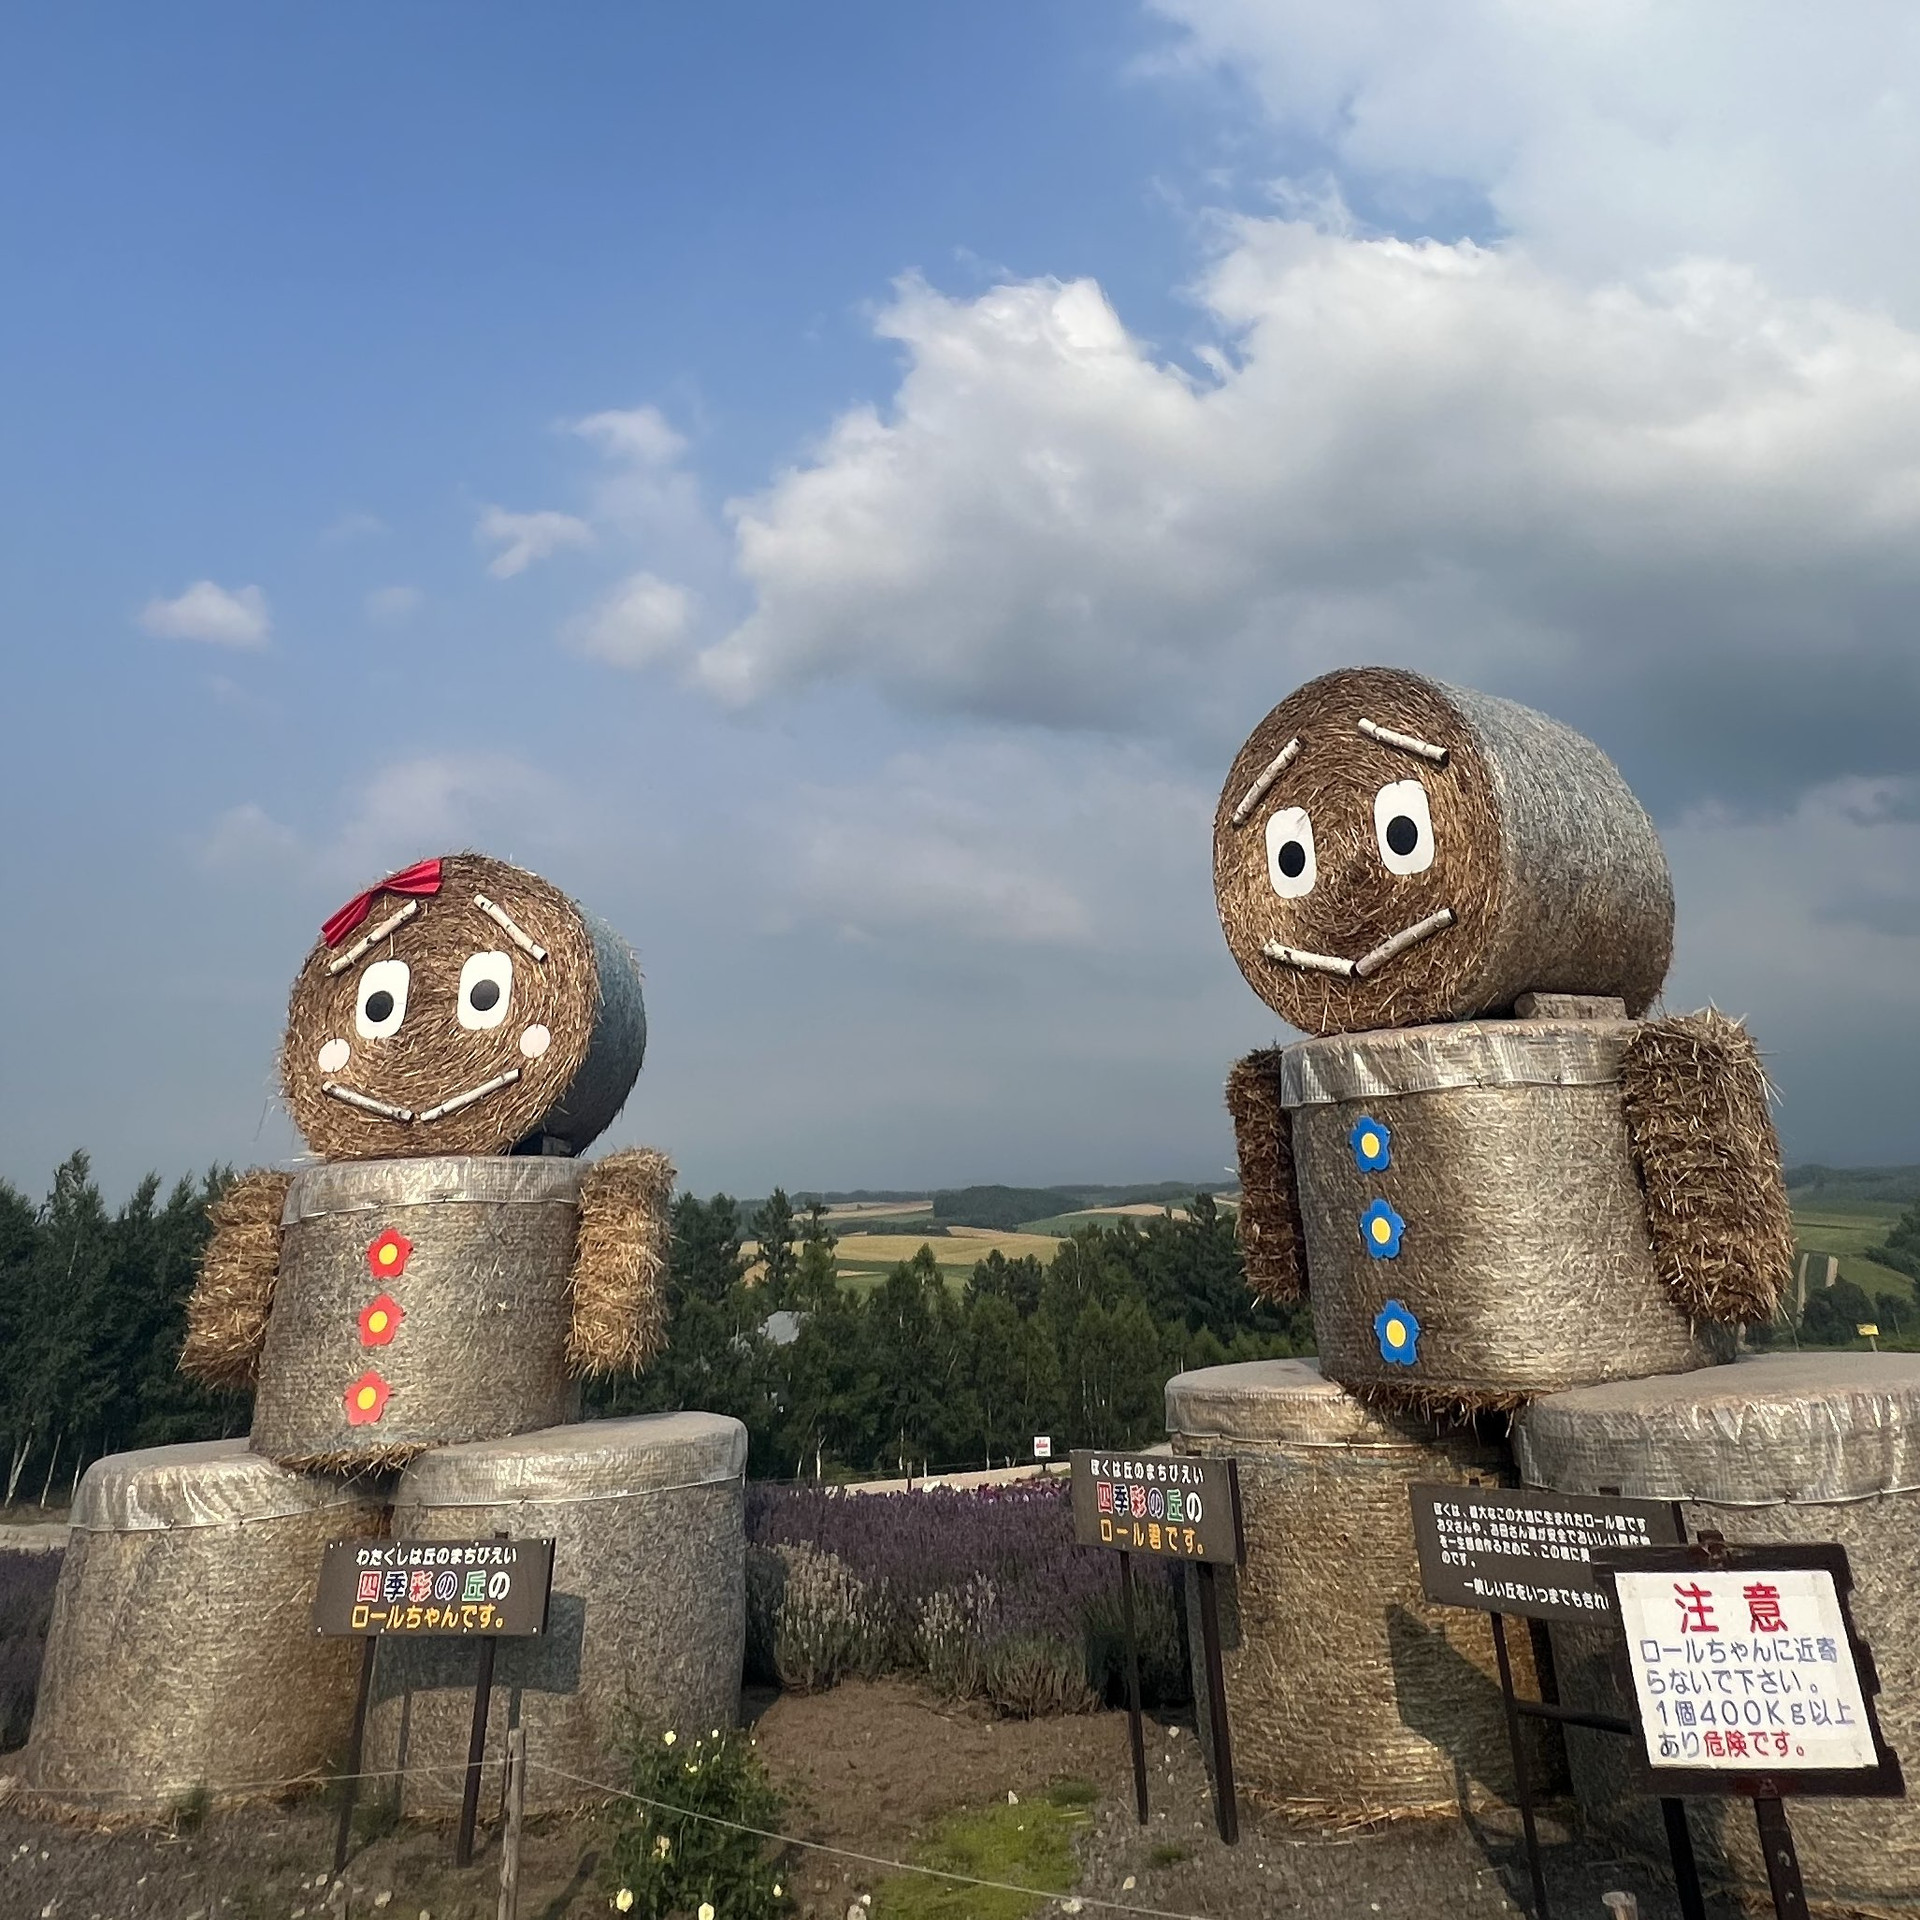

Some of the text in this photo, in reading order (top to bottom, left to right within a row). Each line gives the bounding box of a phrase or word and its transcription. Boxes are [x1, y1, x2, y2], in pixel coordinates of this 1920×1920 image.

[1097, 1481, 1203, 1523] 四季彩の丘の
[1100, 1519, 1204, 1555] ロール君です。
[357, 1569, 511, 1602] 四季彩の丘の
[352, 1603, 504, 1629] ロールちゃんです。
[1673, 1581, 1788, 1634] 注意
[1639, 1637, 1838, 1664] ロールちゃんに近寄
[1646, 1669, 1819, 1694] らないで下さい。
[1658, 1730, 1805, 1758] あり危険です。
